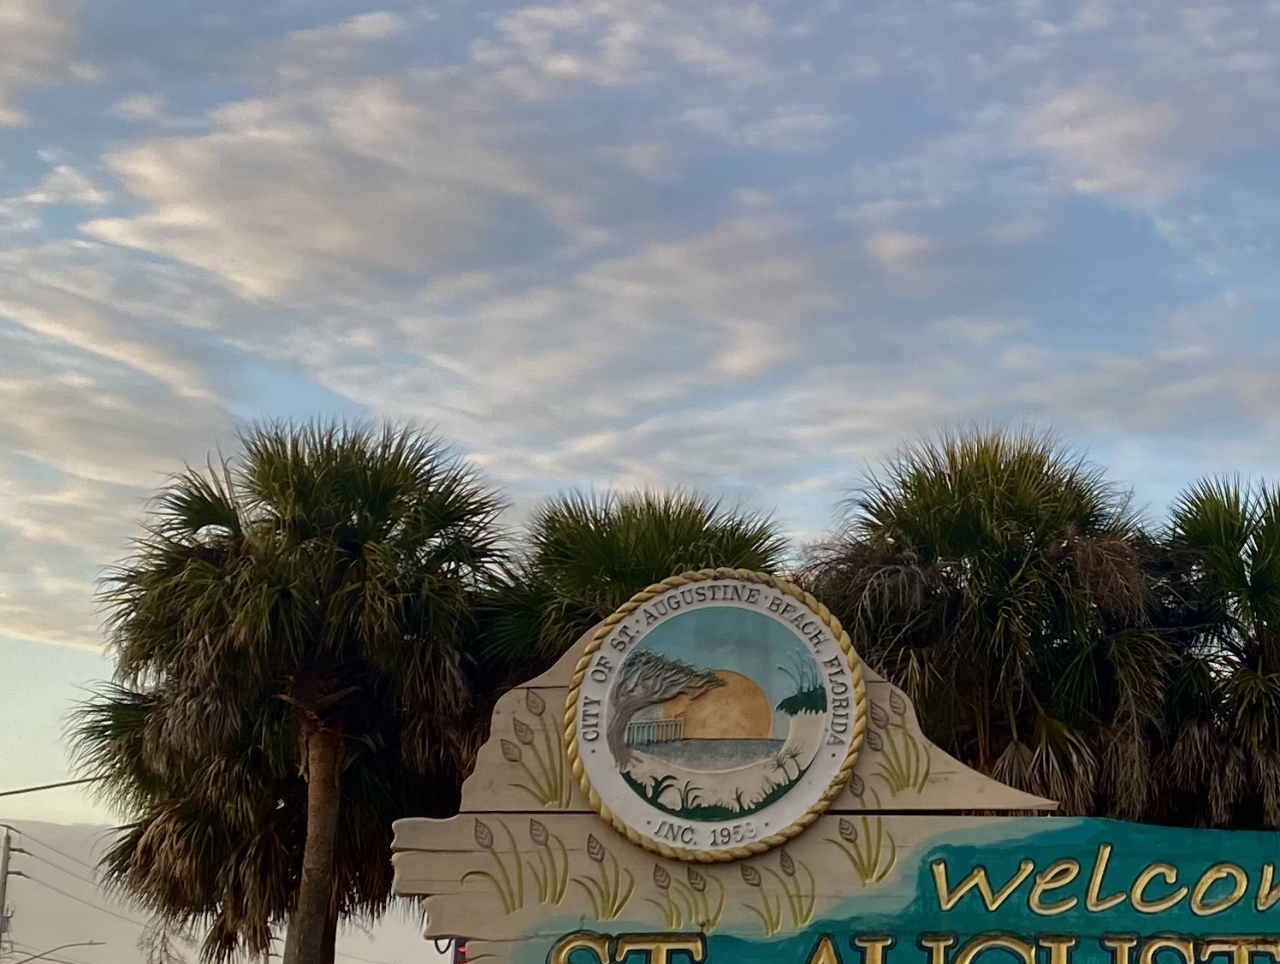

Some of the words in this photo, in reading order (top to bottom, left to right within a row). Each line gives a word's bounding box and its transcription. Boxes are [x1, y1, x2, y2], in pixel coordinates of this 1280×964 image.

[642, 584, 761, 626] AUGUSTINE
[590, 655, 614, 683] OF
[582, 696, 600, 742] CITY
[824, 655, 849, 748] FLORIDA
[653, 821, 697, 846] INC.
